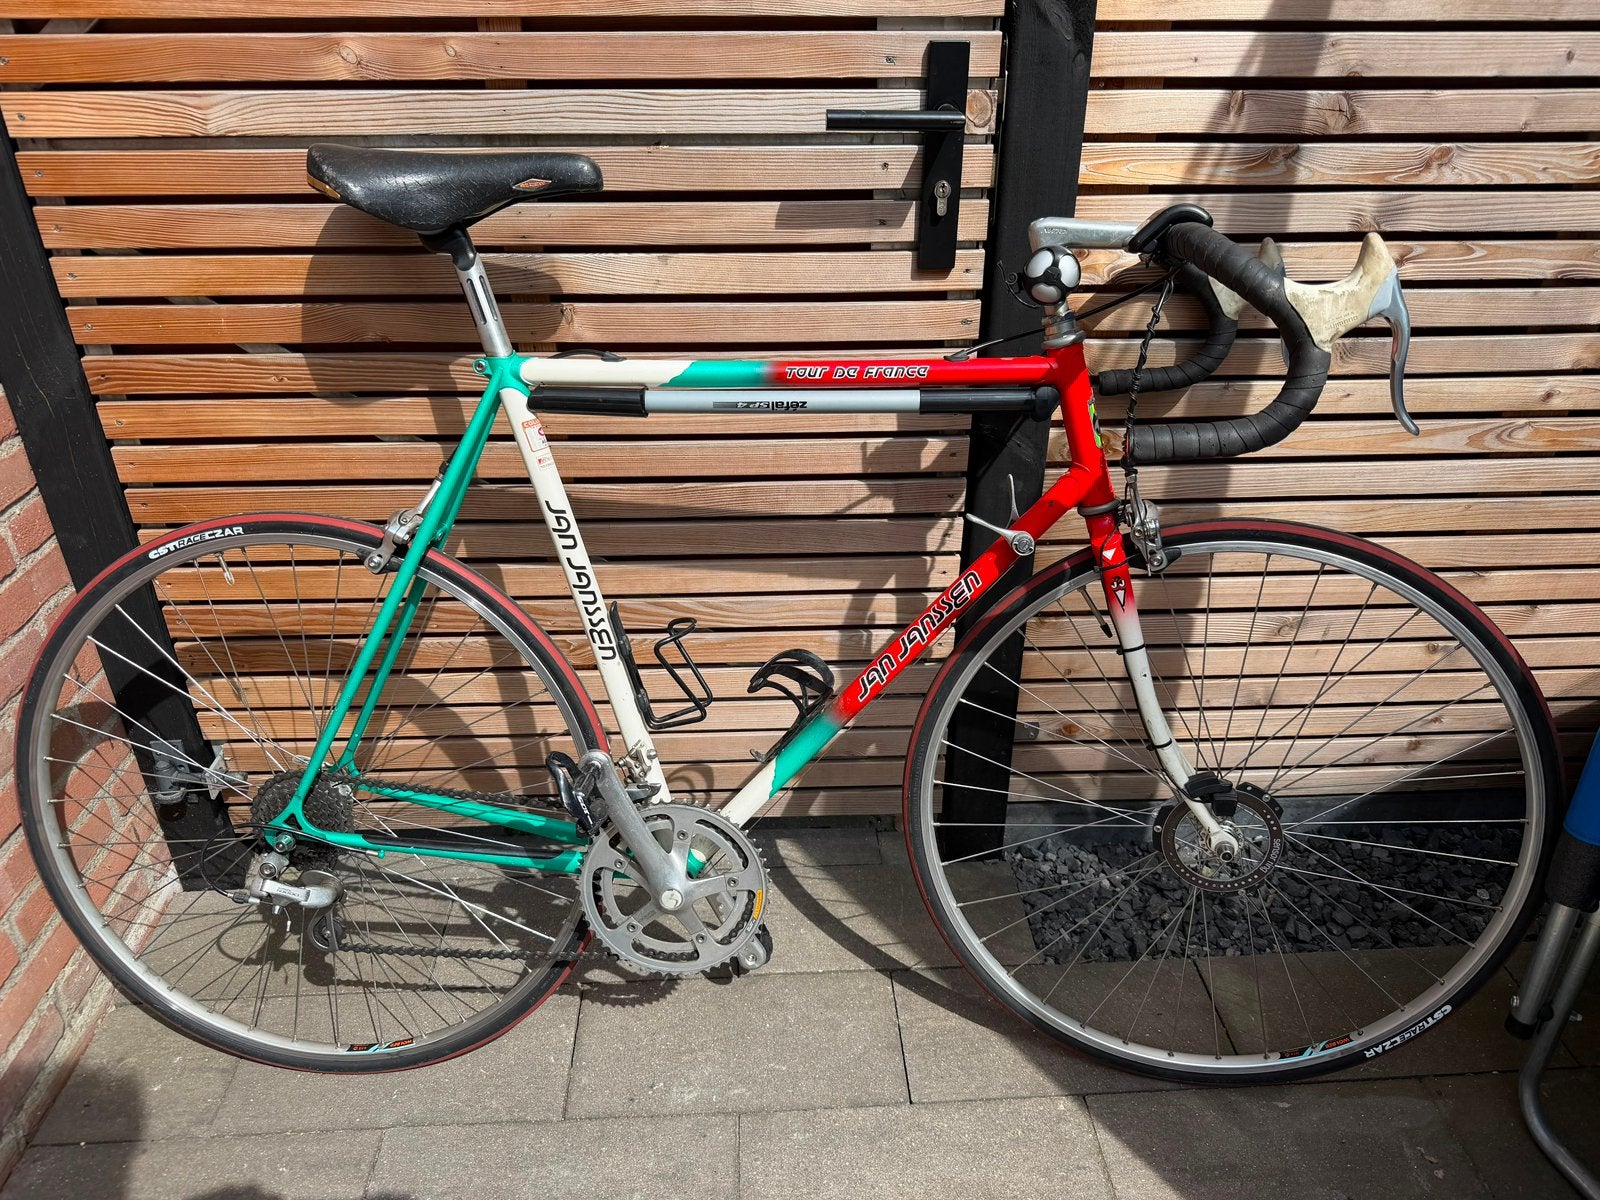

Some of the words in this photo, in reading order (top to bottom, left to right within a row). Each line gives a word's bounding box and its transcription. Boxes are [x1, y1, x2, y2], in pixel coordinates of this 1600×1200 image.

[771, 401, 808, 411] zéfal
[1270, 838, 1281, 862] sensor
[1260, 862, 1276, 874] ring
